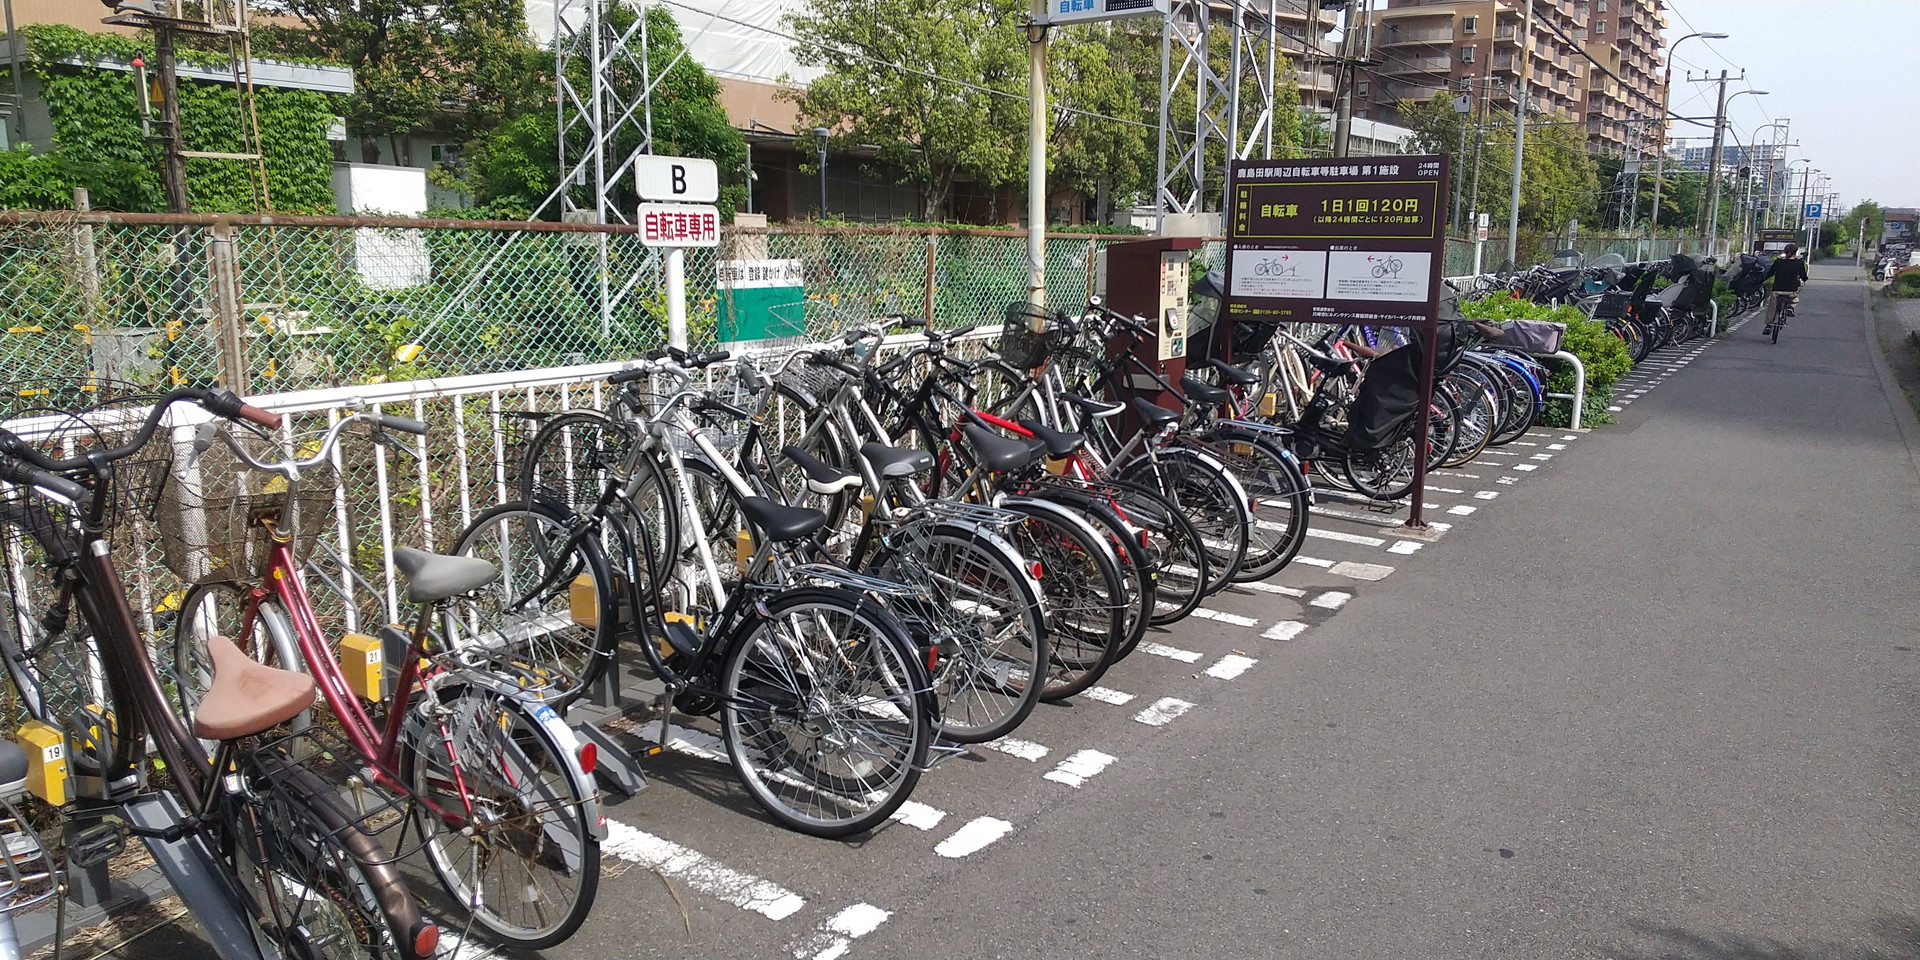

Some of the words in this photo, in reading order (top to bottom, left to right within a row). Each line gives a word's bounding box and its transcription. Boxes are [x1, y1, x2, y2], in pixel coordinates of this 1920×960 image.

[1237, 165, 1359, 178] 鹿島田駅周辺自転車等駐車場
[1362, 164, 1400, 176] 第1施設
[671, 164, 687, 195] B
[1260, 204, 1299, 218] 自転車
[1320, 199, 1419, 213] 1日1回120円
[645, 211, 715, 242] 自転車専用
[748, 266, 760, 282] 登録
[370, 652, 378, 662] 21
[49, 747, 60, 759] 19
